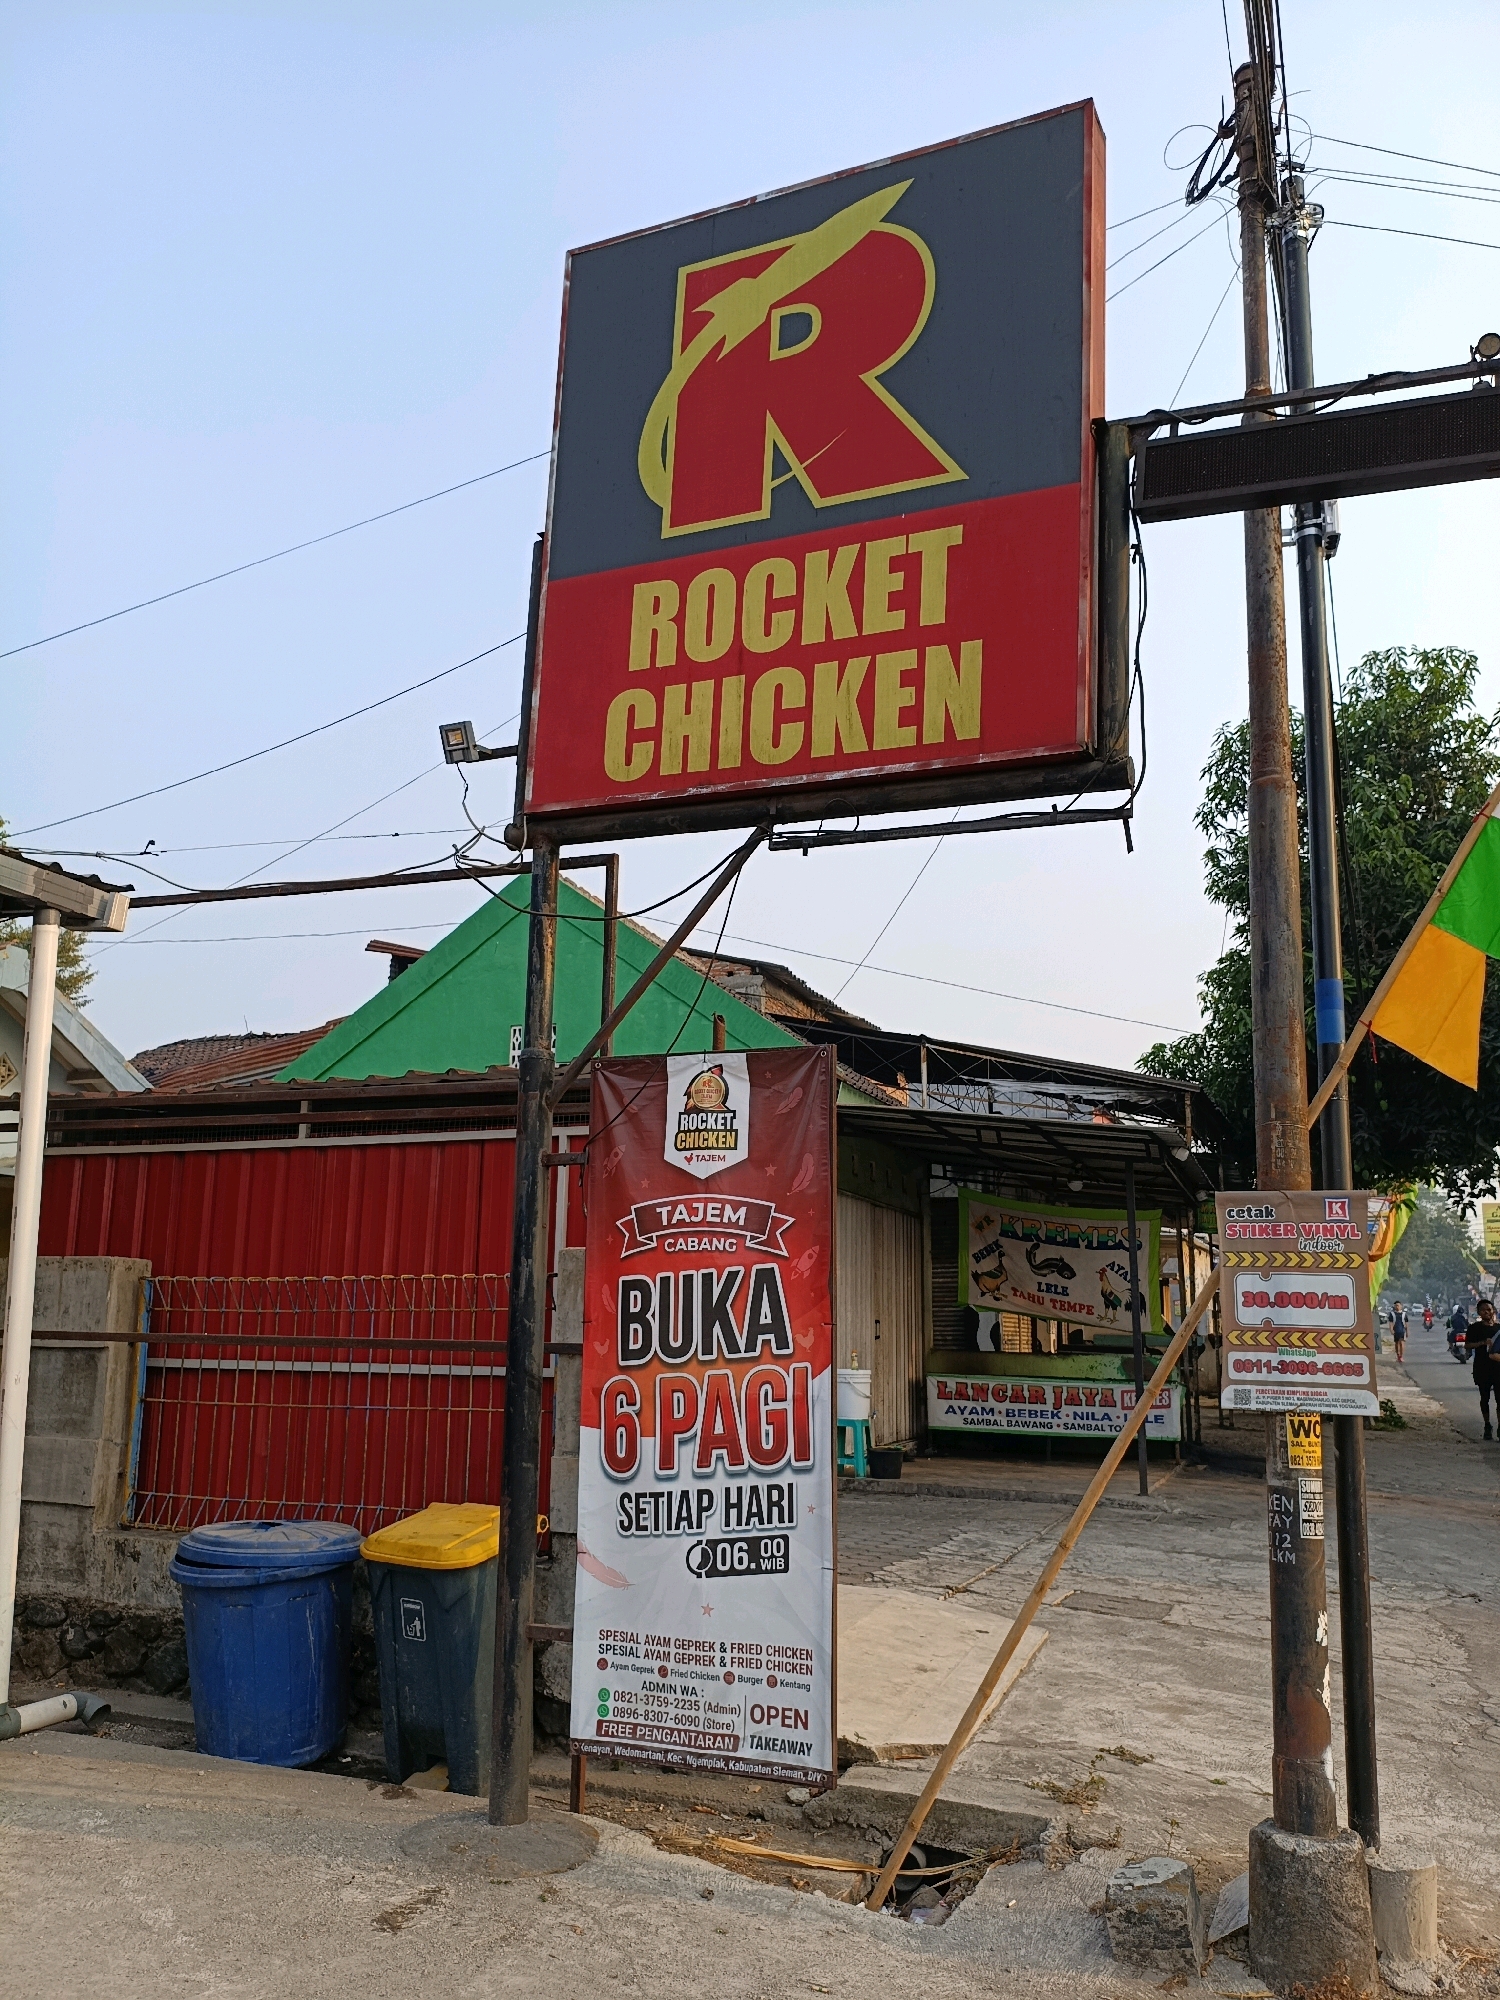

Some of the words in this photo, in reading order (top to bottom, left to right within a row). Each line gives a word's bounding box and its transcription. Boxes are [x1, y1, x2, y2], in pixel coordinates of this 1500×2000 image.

[628, 524, 964, 672] ROCKET
[604, 638, 983, 782] CHICKEN
[680, 1112, 734, 1131] ROCKET
[676, 1131, 736, 1149] CHICKEN
[695, 1154, 726, 1163] TAJEM
[656, 1202, 748, 1226] TAJEM
[1226, 1205, 1275, 1220] cetak
[999, 1213, 1143, 1252] KREMES
[1226, 1222, 1297, 1239] STIKER
[1300, 1223, 1361, 1239] VINYL
[664, 1238, 737, 1252] CABANG
[971, 1239, 1003, 1265] BEBEK
[1299, 1235, 1344, 1252] indoor
[1106, 1261, 1141, 1283] AYA
[1037, 1281, 1070, 1297] LELE
[1241, 1291, 1350, 1309] 30.000/m
[1010, 1286, 1045, 1307] TAHU
[1051, 1300, 1095, 1316] TEMPE
[618, 1264, 793, 1366] BUKA
[1278, 1347, 1317, 1358] WhatsApp
[1233, 1358, 1365, 1377] 0811-3096-6665
[937, 1380, 1046, 1405] LANCAR
[1052, 1387, 1116, 1410] JAYA
[601, 1375, 641, 1479] 6
[655, 1362, 814, 1477] PAGI
[945, 1404, 995, 1417] AYAM
[1005, 1408, 1062, 1420] BEBEK
[1073, 1411, 1113, 1421] NILA
[1123, 1413, 1165, 1424] LLE
[962, 1417, 1004, 1427] SAMBAL
[1006, 1419, 1053, 1430] BAWANG
[1063, 1421, 1105, 1432] SAMBAL
[1289, 1419, 1321, 1439] WC
[617, 1488, 714, 1534] SETIAP
[722, 1482, 797, 1528] HARI
[1268, 1493, 1294, 1512] KEN
[1268, 1513, 1293, 1529] FAY
[760, 1538, 785, 1557] 00
[760, 1557, 785, 1570] WIB
[599, 1629, 641, 1645] SPESIAL
[644, 1634, 671, 1649] AYAM
[674, 1638, 716, 1653] GEPREK
[719, 1641, 728, 1654] &
[730, 1642, 763, 1656] FRIED
[766, 1645, 813, 1662] CHICKEN
[598, 1643, 641, 1659] SPESIAL
[643, 1648, 671, 1663] AYAM
[674, 1652, 716, 1667] GEPREK
[719, 1655, 728, 1668] &
[730, 1656, 763, 1670] FRIED
[766, 1659, 813, 1676] CHICKEN
[610, 1661, 630, 1672] Ayam
[630, 1663, 656, 1675] Geprek
[670, 1668, 689, 1679] Fried
[689, 1670, 721, 1682] Chicken
[737, 1674, 764, 1686] Burger
[780, 1679, 811, 1692] Kentang
[641, 1680, 679, 1696] ADMIN
[680, 1685, 699, 1698] WA
[613, 1690, 701, 1712] 0821-3759-2235
[703, 1701, 742, 1718] (Admin)
[612, 1705, 700, 1728] 0896-8307-6090
[702, 1716, 736, 1733] (Store)
[750, 1703, 809, 1731] OPEN
[601, 1722, 634, 1739] FREE
[636, 1726, 734, 1750] PENGANTARAN
[749, 1734, 813, 1757] TAKEAWAY
[614, 1746, 666, 1762] Wedomartani,
[667, 1752, 685, 1764] Kec.
[728, 1759, 772, 1775] Kabupaten
[773, 1766, 806, 1781] Sleman,
